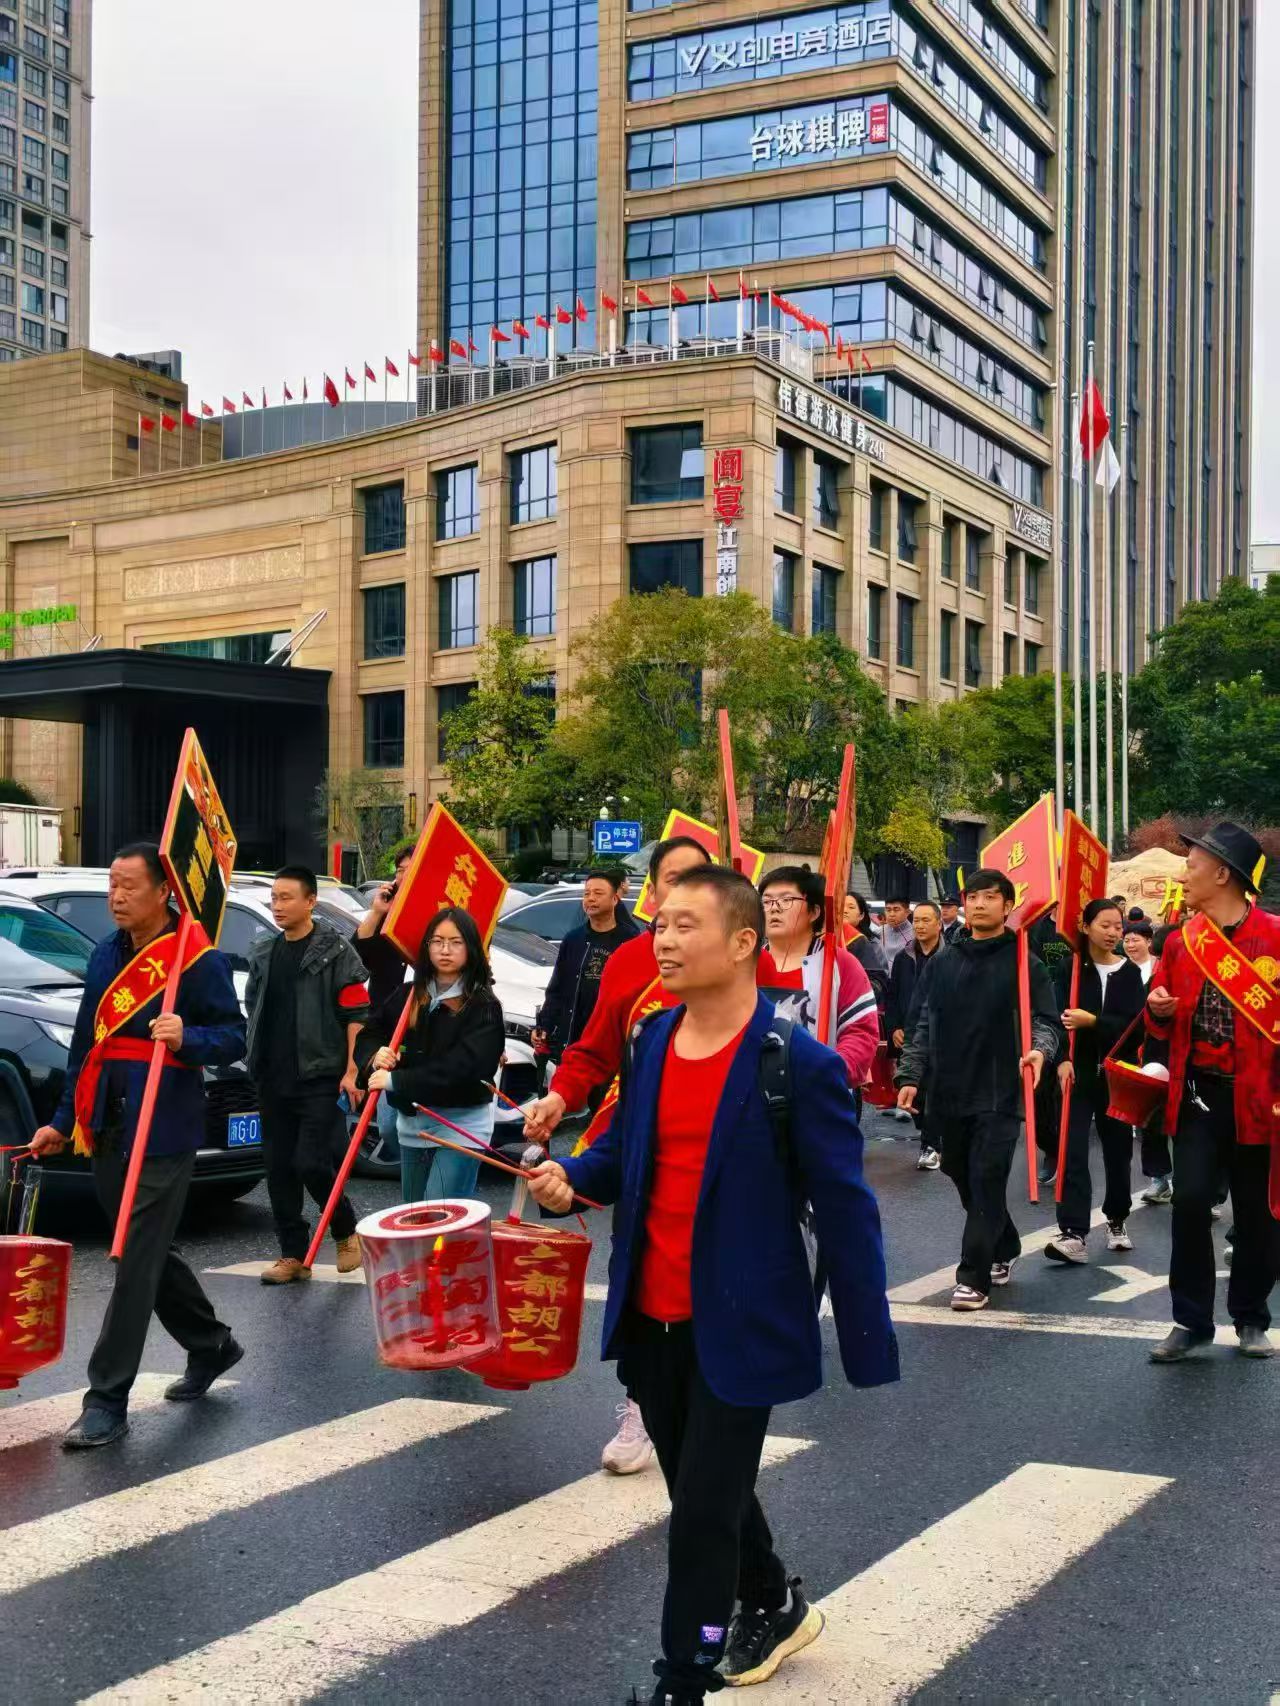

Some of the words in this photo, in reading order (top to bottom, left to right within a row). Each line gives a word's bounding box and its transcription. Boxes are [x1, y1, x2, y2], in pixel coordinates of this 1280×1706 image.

[750, 109, 867, 162] 台球棋牌
[871, 106, 887, 140] 二楼
[598, 831, 611, 850] P
[613, 827, 637, 838] 停车场
